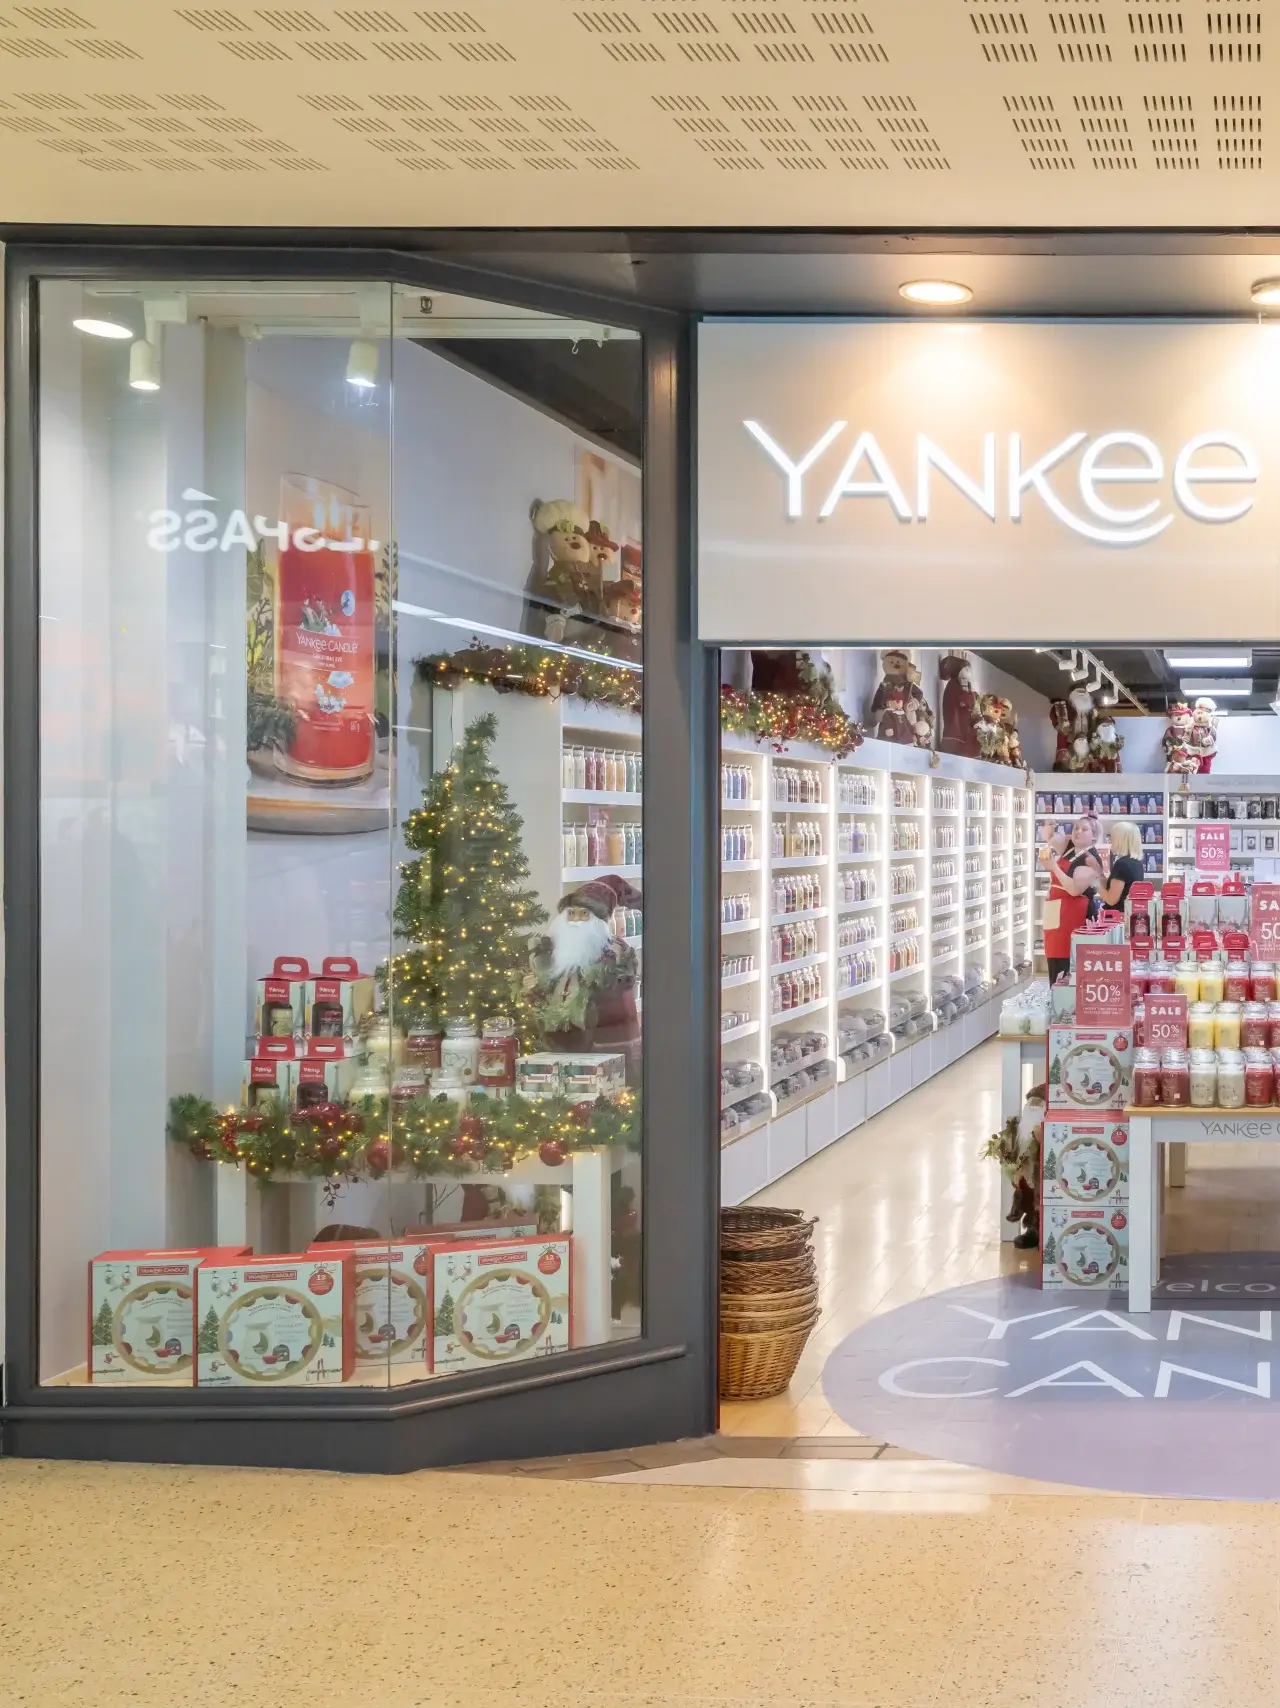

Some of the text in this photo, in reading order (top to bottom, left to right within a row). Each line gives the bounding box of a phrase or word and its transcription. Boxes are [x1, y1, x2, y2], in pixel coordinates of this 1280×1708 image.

[1201, 847, 1224, 858] 50%
[1083, 960, 1123, 972] SALE
[1085, 984, 1121, 1003] 50%
[1151, 1006, 1181, 1015] SALE
[1152, 1024, 1180, 1038] 50%
